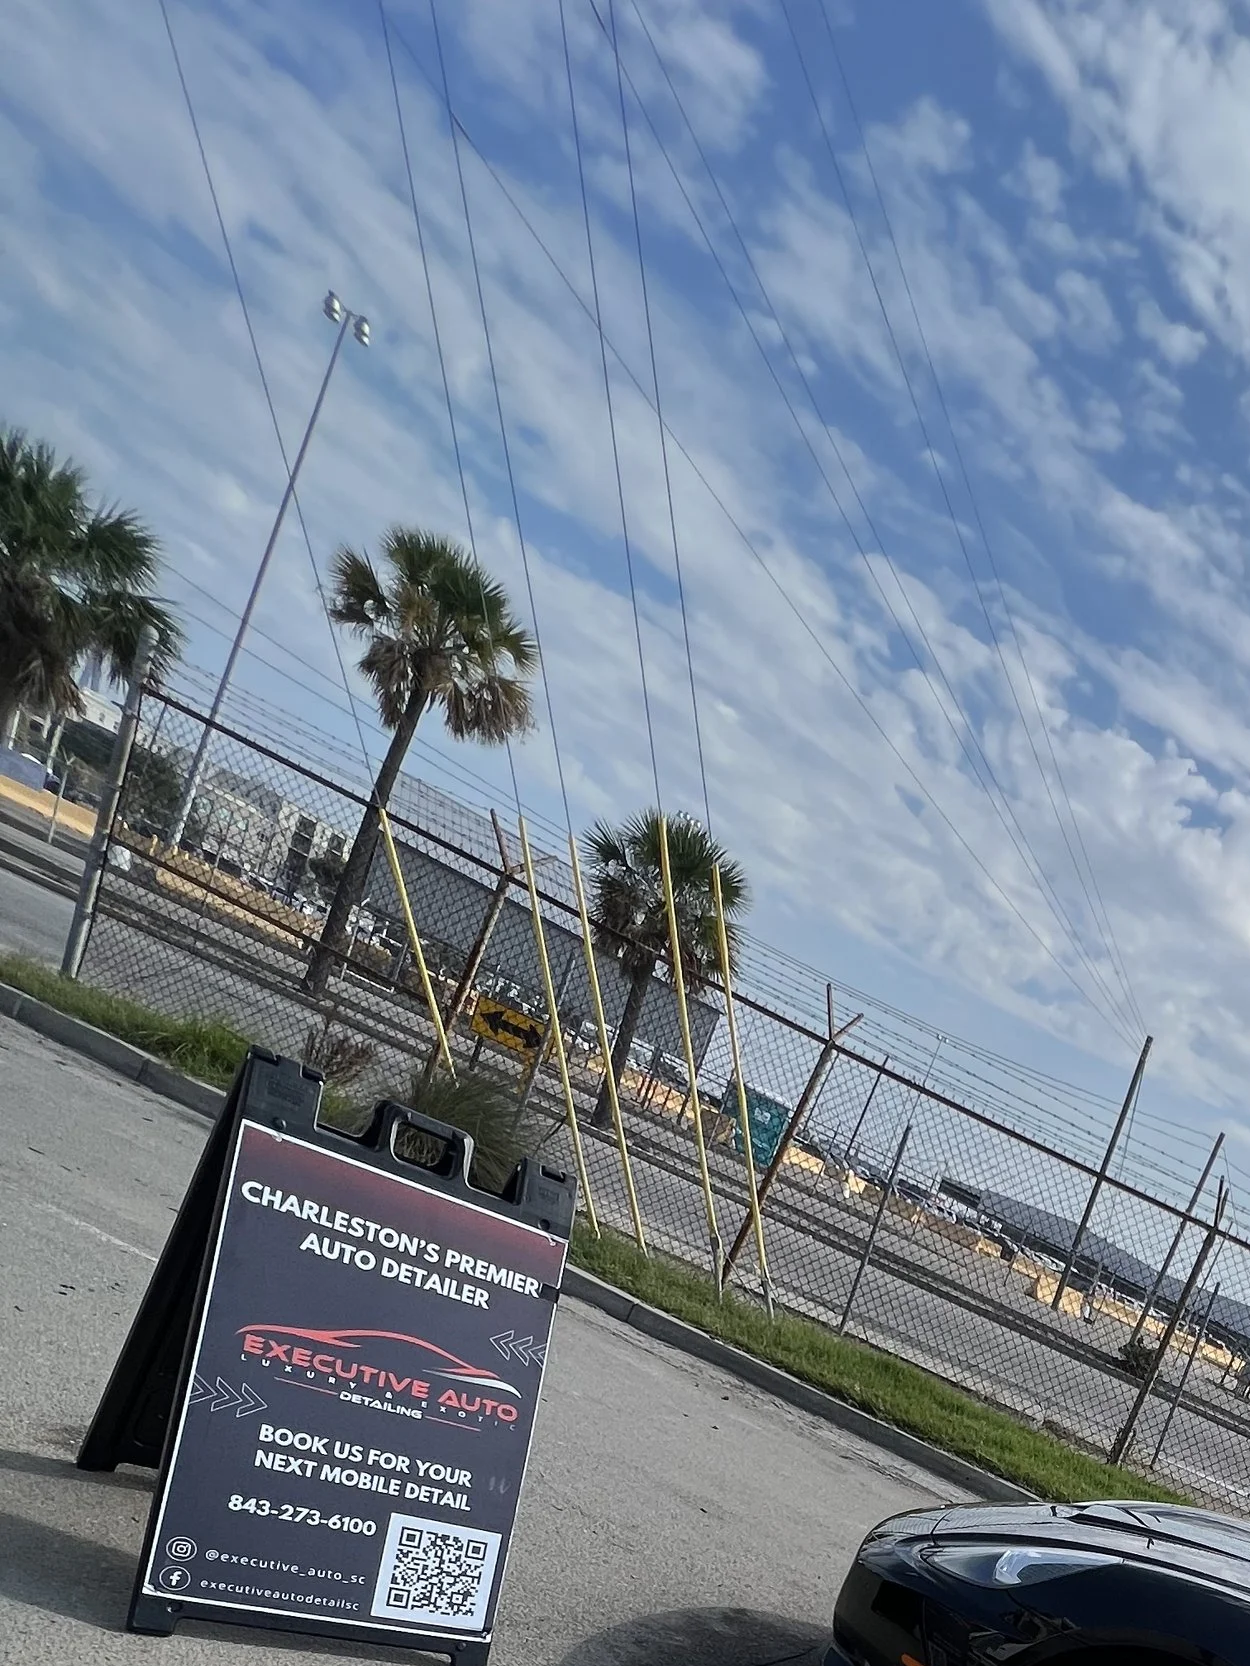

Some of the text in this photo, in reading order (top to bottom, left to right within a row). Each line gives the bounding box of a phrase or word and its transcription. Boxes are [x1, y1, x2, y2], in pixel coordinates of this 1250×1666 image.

[240, 1180, 540, 1298] CHARLESTON'S PREMIER
[299, 1232, 490, 1309] AUTO DETAILER
[240, 1354, 357, 1389] LUXURY
[421, 1400, 516, 1431] EXOTIC
[243, 1334, 518, 1423] EXECUTIVE AUTO
[339, 1391, 423, 1420] DETAILING
[254, 1450, 471, 1511] NEXT MOBILE DETAIL
[259, 1424, 472, 1487] BOOK US FOR YOUR
[227, 1494, 377, 1536] 843-273-6100
[200, 1579, 360, 1611] executiveautodetailsc
[205, 1549, 366, 1585] @executive_auto_sc
